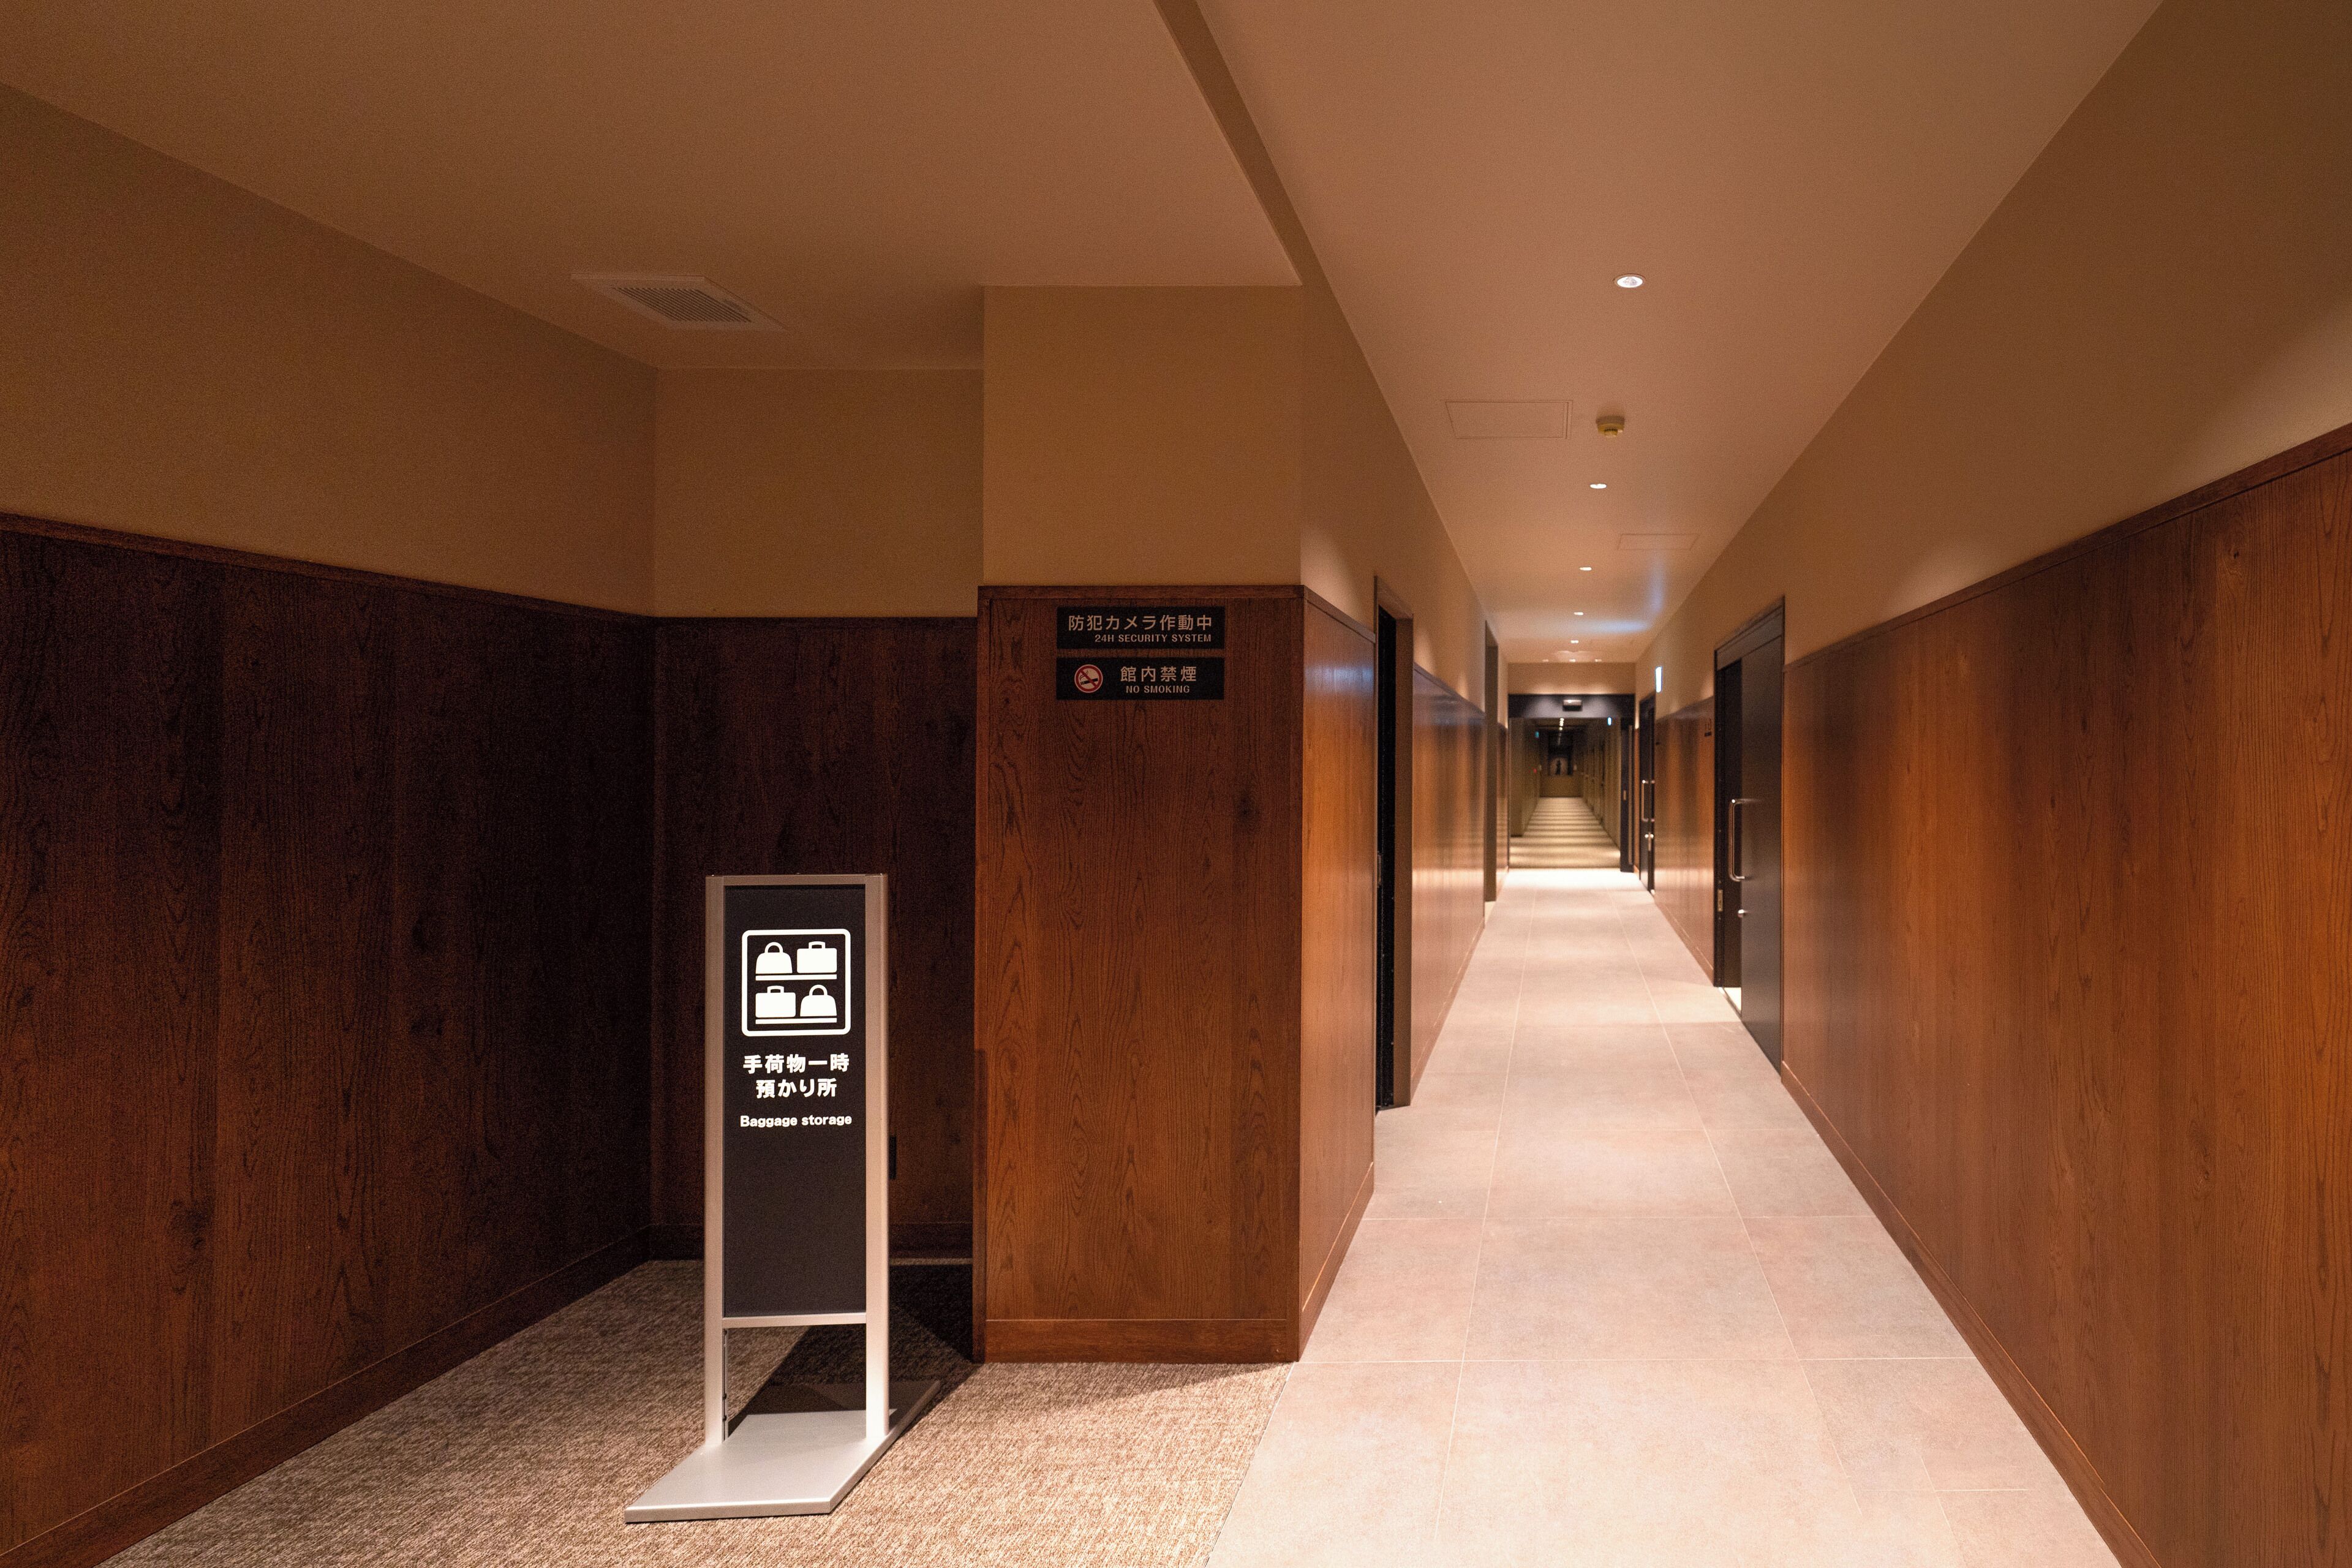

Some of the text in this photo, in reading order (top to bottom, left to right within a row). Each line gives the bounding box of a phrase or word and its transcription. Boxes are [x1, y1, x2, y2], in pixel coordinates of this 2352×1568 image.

[1068, 615, 1212, 631] 防犯カメラ作動中
[1120, 666, 1197, 683] 館内禁煙
[1144, 685, 1190, 694] SMOKING
[743, 1053, 850, 1074] 手荷物一時
[756, 1078, 837, 1099] 預かり所
[740, 1115, 853, 1128] Baggage storage
